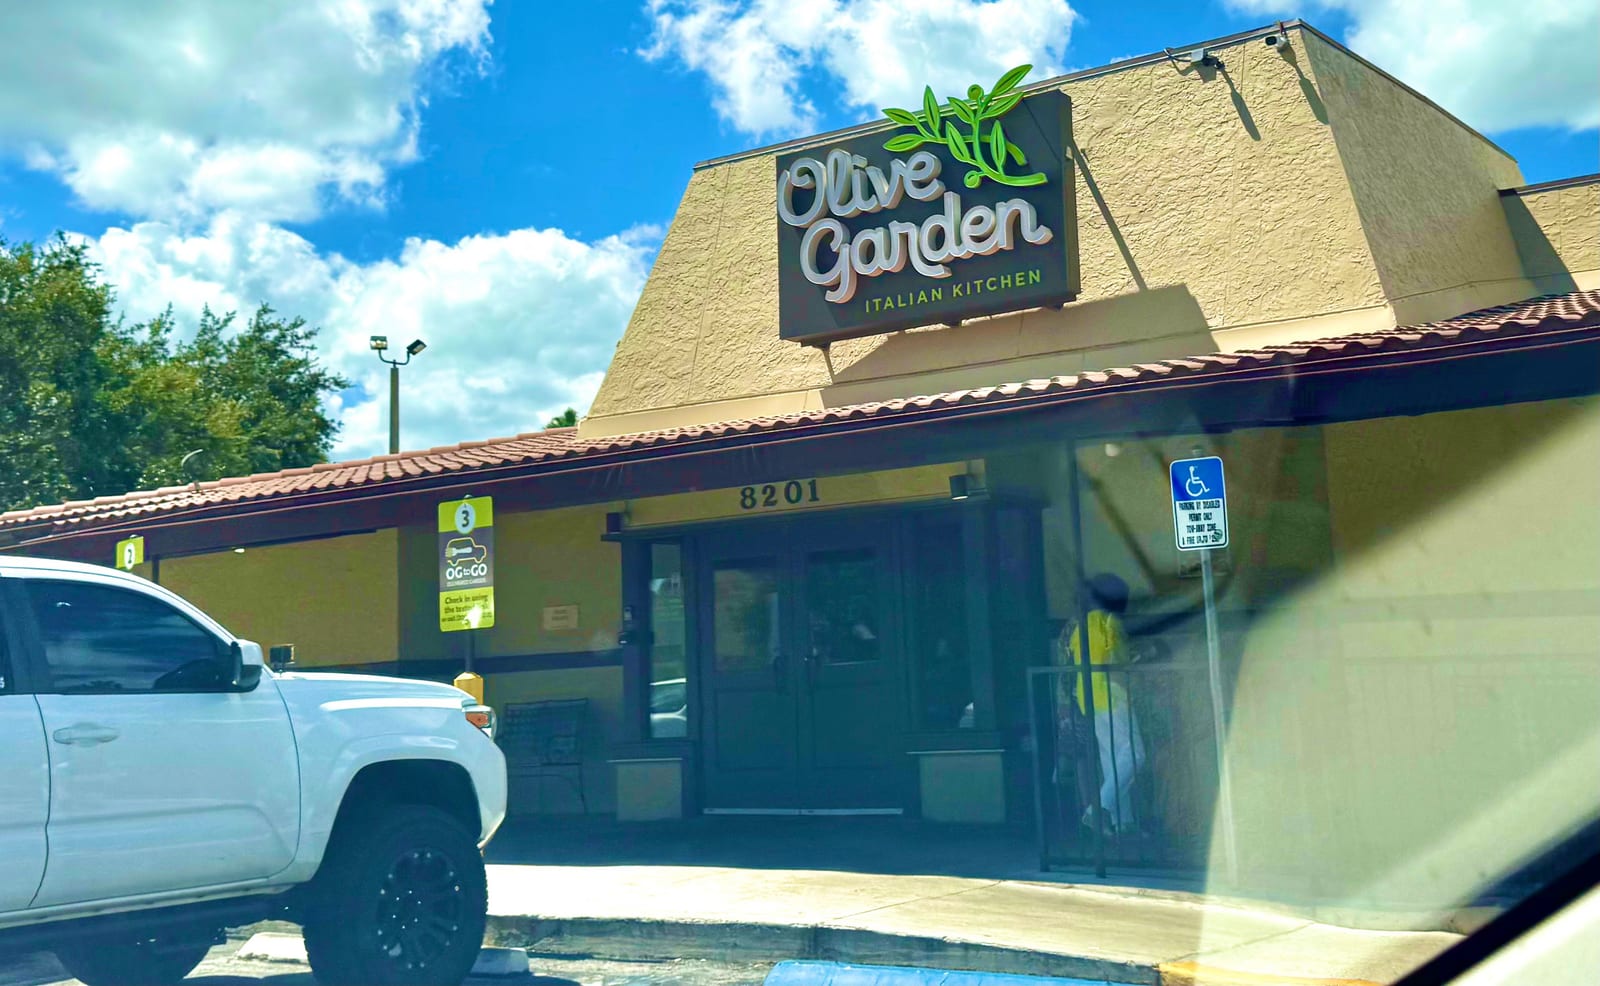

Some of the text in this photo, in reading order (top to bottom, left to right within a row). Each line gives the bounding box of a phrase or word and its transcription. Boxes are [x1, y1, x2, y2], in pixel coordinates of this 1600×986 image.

[777, 148, 946, 228] Olive
[799, 191, 1053, 304] Garden
[865, 268, 1041, 313] ITALIAN KITCHEN
[740, 479, 820, 510] 8201
[461, 510, 470, 528] 3
